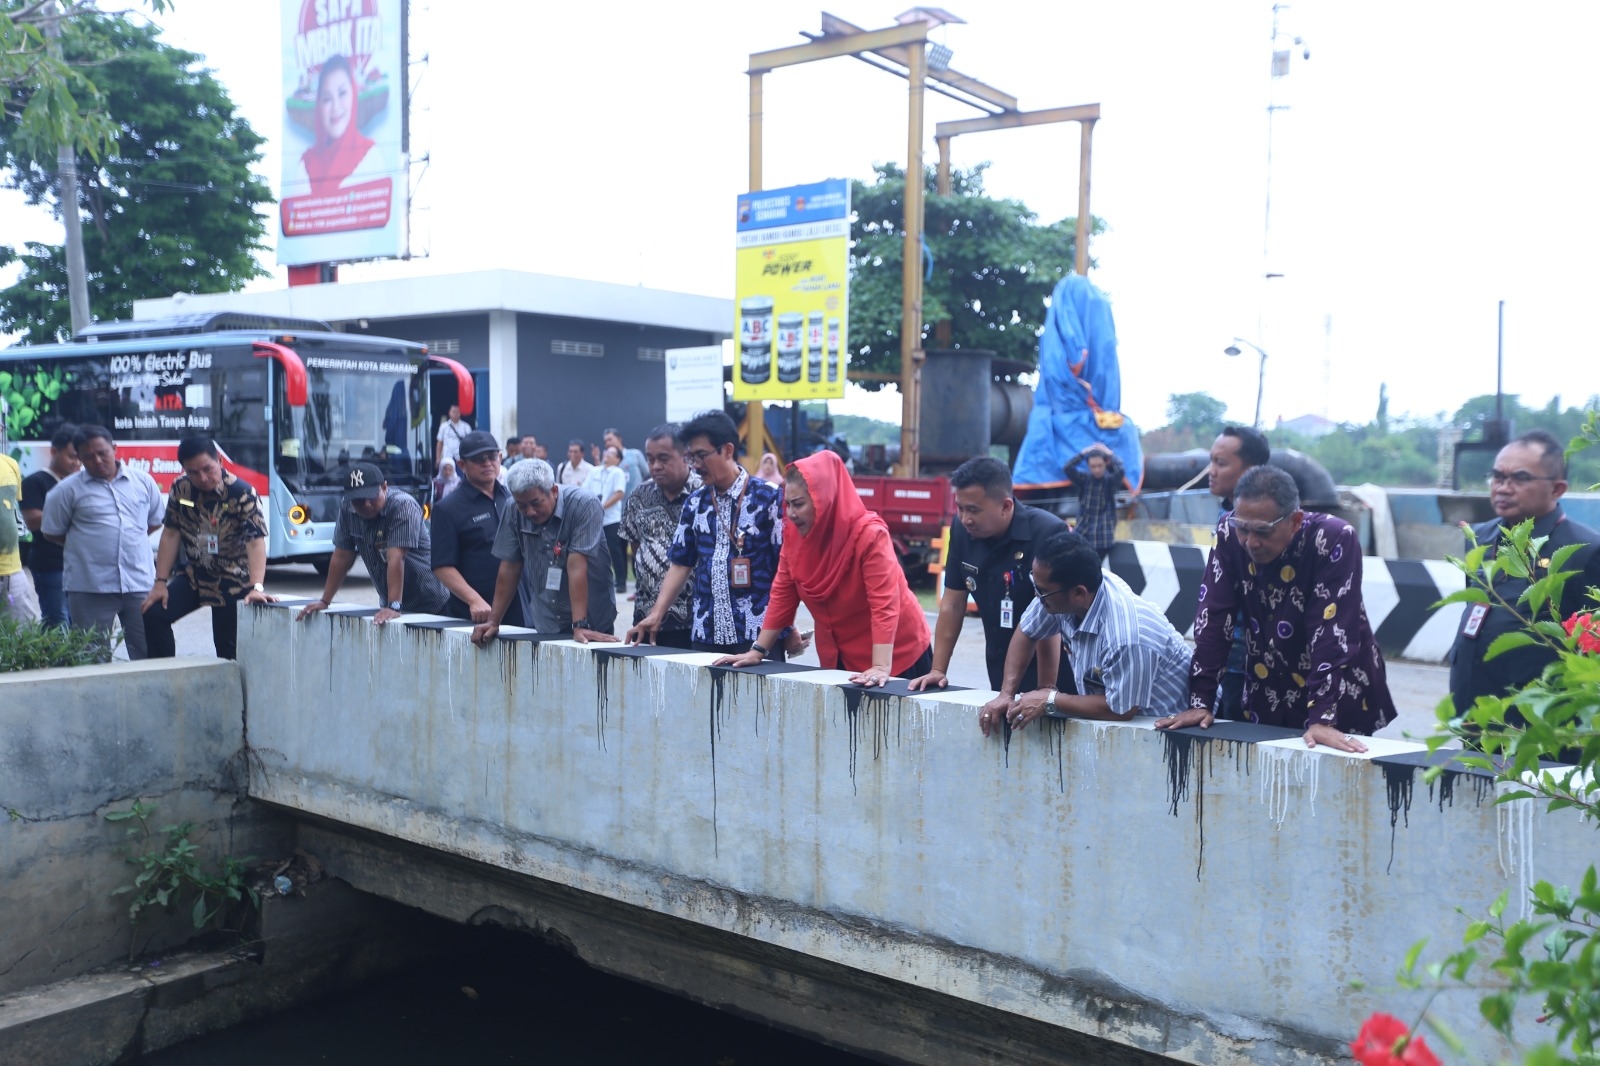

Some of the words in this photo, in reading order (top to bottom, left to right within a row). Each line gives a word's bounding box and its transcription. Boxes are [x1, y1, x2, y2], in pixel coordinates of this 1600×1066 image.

[296, 19, 353, 67] MBAK
[355, 15, 382, 55] ITA
[762, 260, 813, 276] POWER
[743, 320, 769, 333] ABC
[110, 355, 142, 373] 100%
[145, 352, 186, 372] Electric
[189, 351, 212, 369] Bus
[307, 357, 358, 371] PEMERINTAH
[358, 361, 379, 372] KOTA
[379, 362, 418, 374] SEMARANG
[114, 416, 133, 429] kota
[134, 415, 158, 428] Indah
[159, 414, 186, 430] Tanpa
[187, 414, 210, 430] Asap
[350, 469, 365, 488] NY
